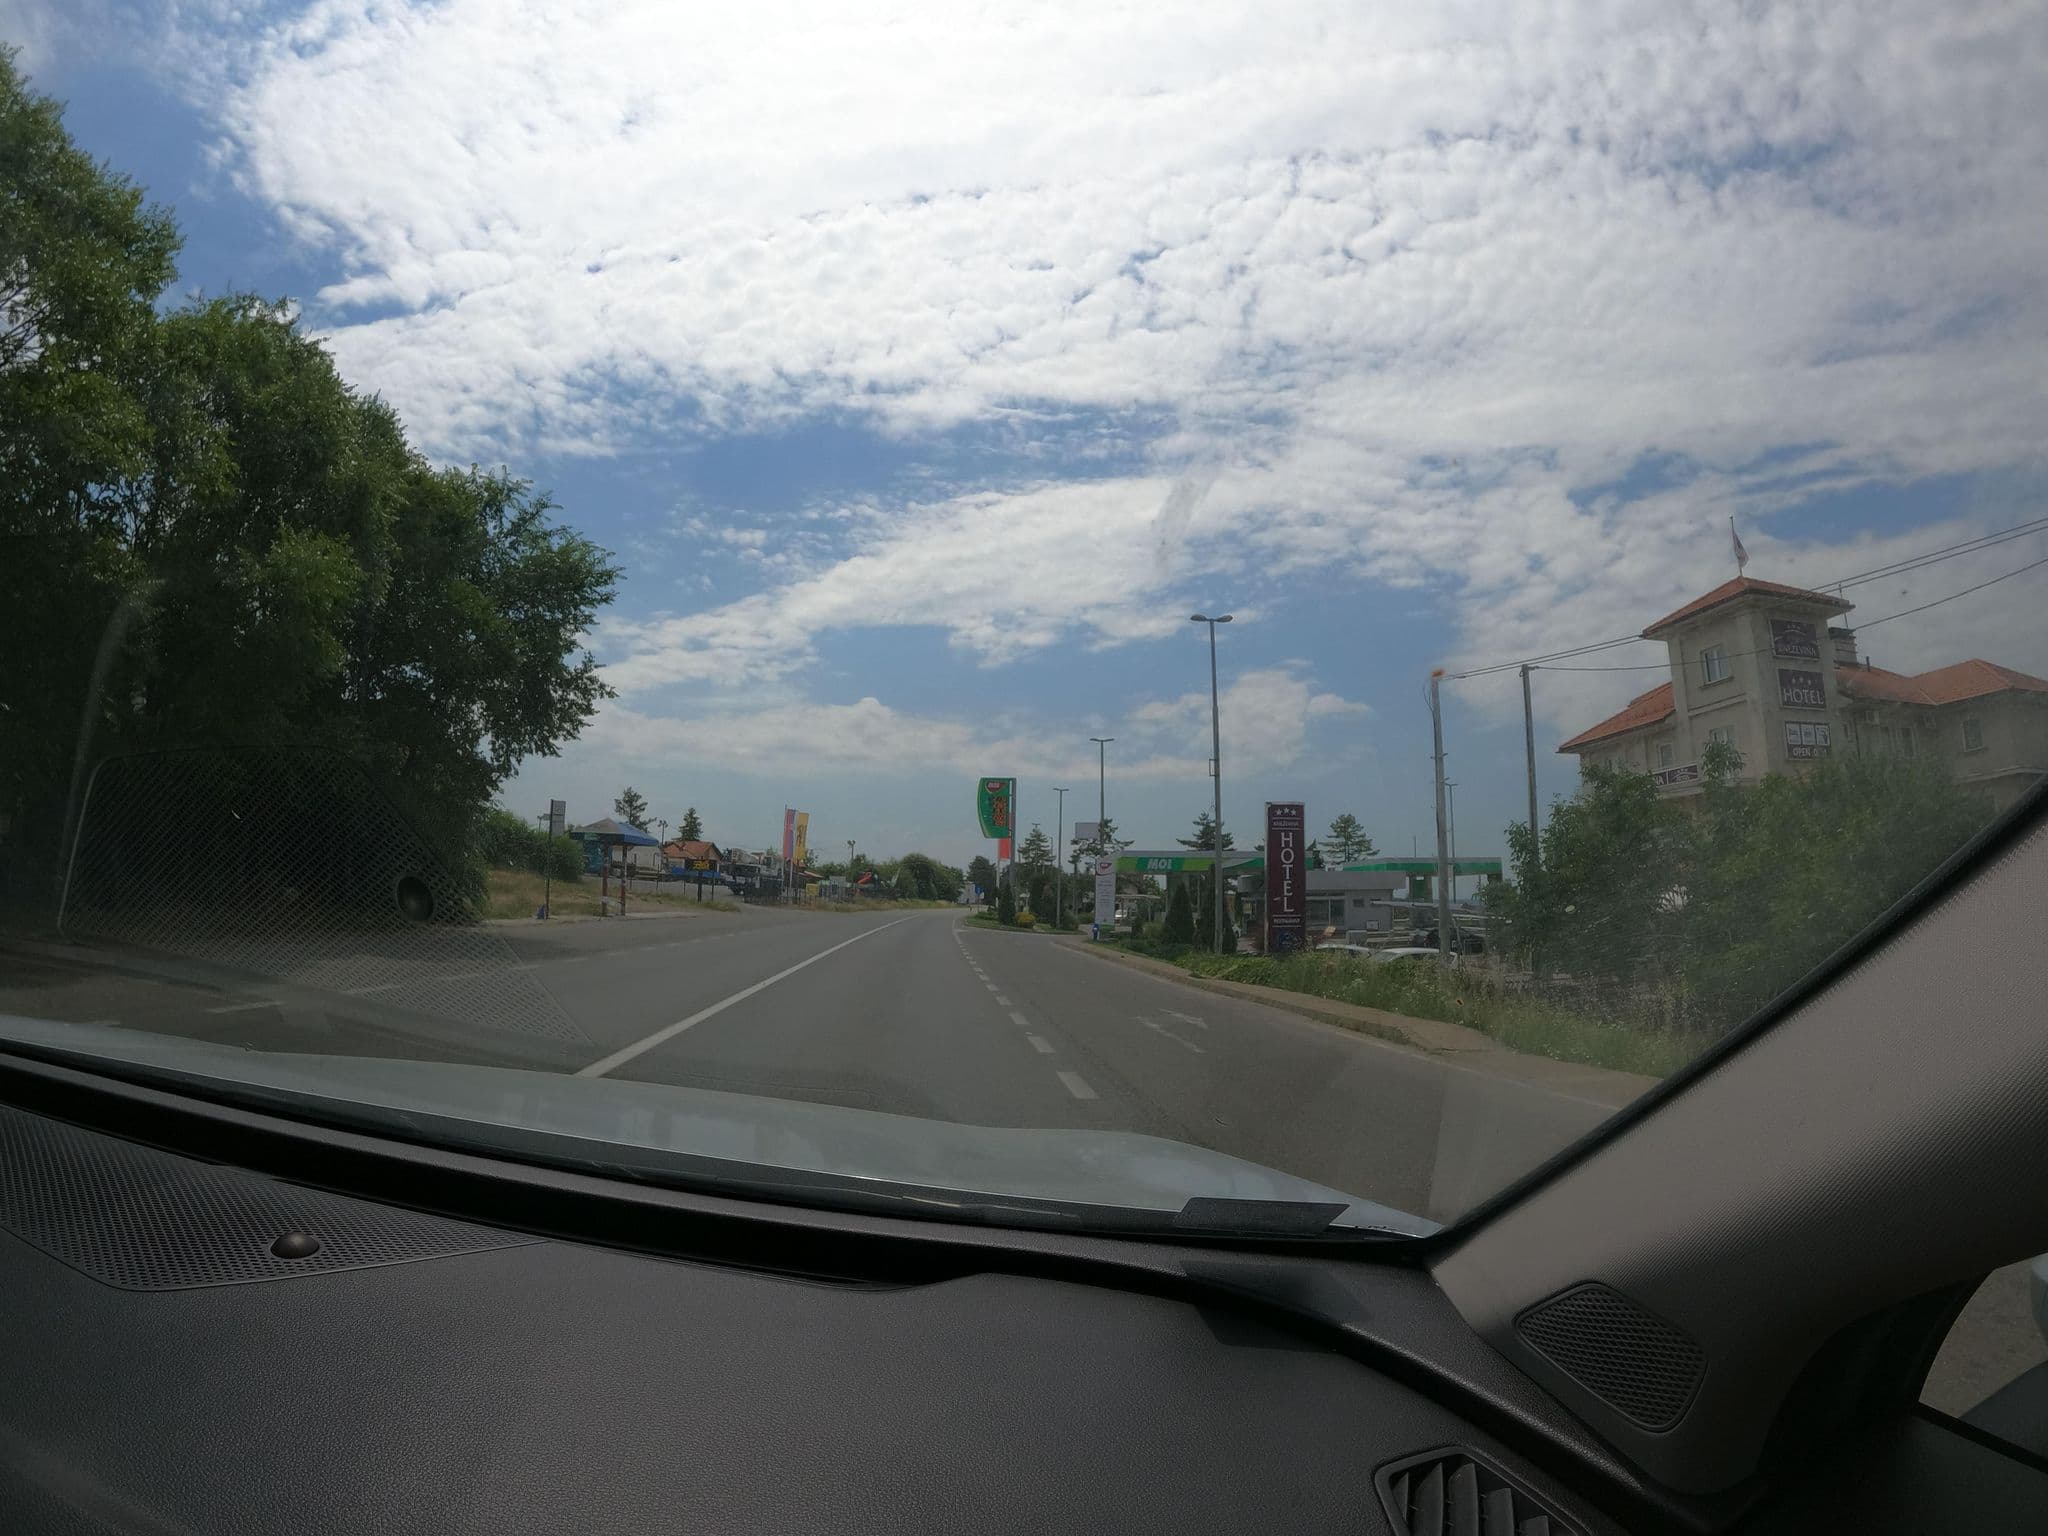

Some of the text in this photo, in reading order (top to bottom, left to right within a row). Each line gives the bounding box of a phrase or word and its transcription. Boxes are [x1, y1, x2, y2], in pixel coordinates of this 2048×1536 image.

[1783, 687, 1824, 705] HOTEL
[1147, 858, 1172, 870] MOL
[1280, 831, 1295, 913] HOTEL
